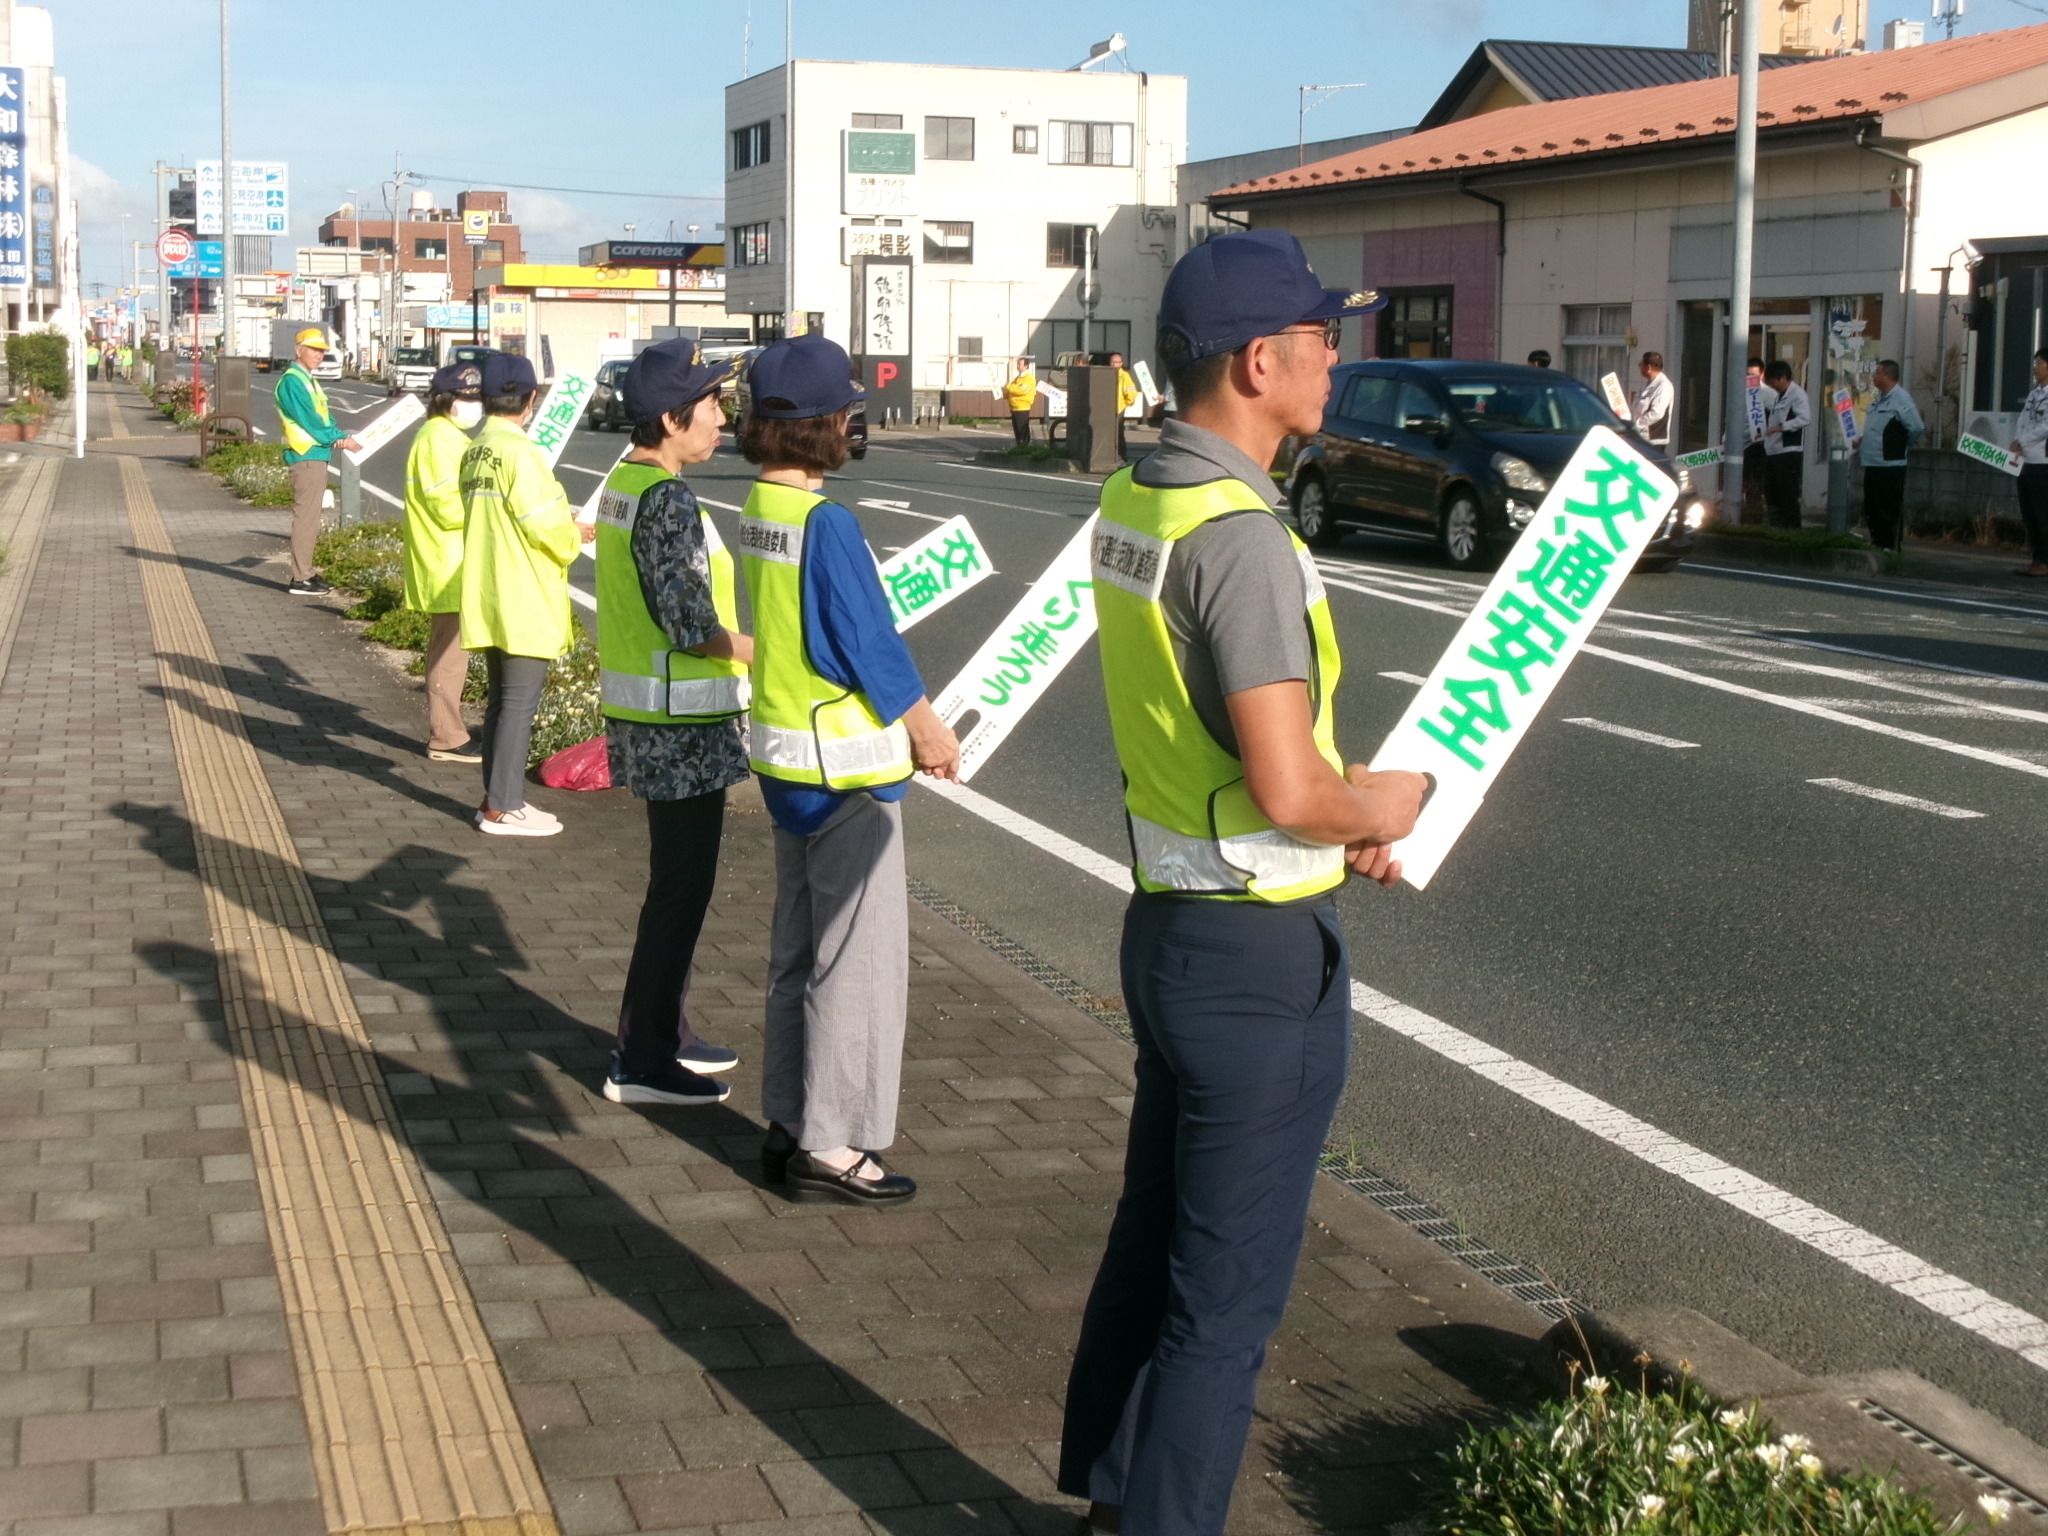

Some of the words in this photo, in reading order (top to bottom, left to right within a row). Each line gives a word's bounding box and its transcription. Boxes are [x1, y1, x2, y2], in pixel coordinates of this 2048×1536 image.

[611, 244, 686, 257] carenex
[878, 233, 911, 256] 撮影
[876, 362, 898, 388] P
[884, 528, 982, 624] 交通
[1416, 445, 1662, 773] 交通安全
